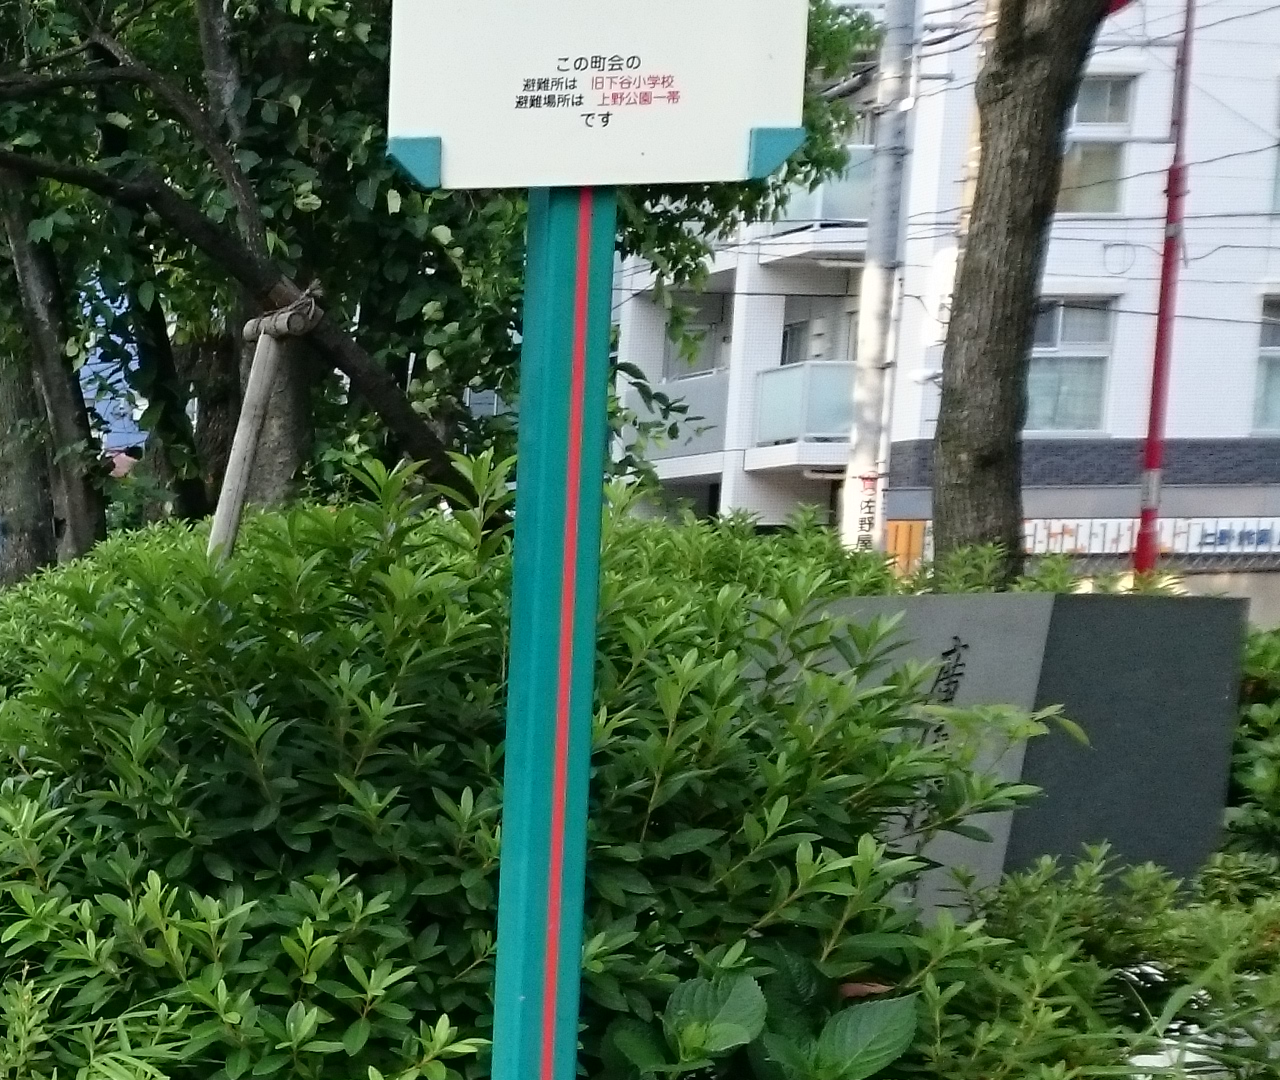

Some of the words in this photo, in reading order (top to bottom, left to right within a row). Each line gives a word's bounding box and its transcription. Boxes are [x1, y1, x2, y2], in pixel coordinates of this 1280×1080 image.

[556, 54, 641, 72] この町会の
[522, 77, 578, 92] 避難所は
[591, 75, 675, 90] 旧下谷小学校
[515, 94, 584, 109] 避難場所は
[597, 91, 680, 107] 上野公園一帯
[580, 111, 613, 128] です
[856, 499, 876, 550] 佐野屋
